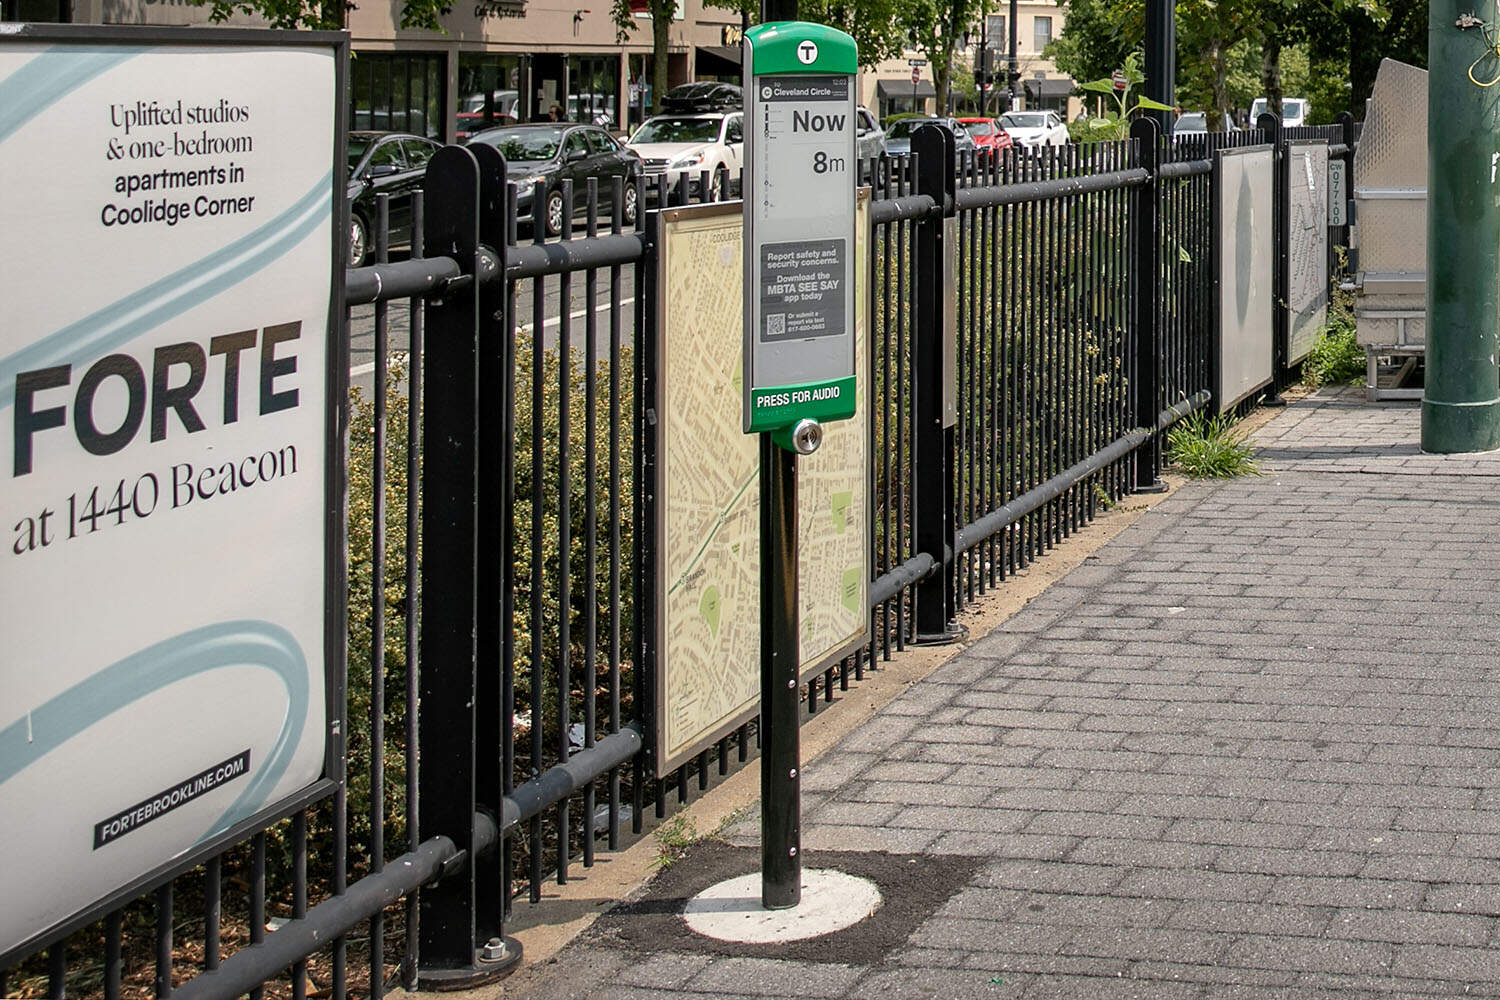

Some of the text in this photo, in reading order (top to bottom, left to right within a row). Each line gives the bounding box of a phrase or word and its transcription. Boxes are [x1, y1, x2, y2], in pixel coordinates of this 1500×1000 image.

[800, 46, 815, 60] T
[774, 87, 809, 96] Cleveland
[810, 87, 832, 96] Circle
[110, 99, 250, 135] Uplifted studios
[793, 110, 846, 132] Now
[106, 130, 253, 160] & one-bedroom
[813, 151, 845, 174] 8m
[1330, 163, 1343, 171] CW
[115, 162, 245, 198] apartments in
[101, 195, 255, 227] Coolidge Corner
[767, 249, 836, 261] Report safety and
[767, 258, 839, 269] security concerns.
[767, 280, 839, 295] MBTA SEE SAY
[777, 271, 830, 283] Download the
[784, 292, 822, 303] app today
[13, 320, 303, 478] FORTE
[757, 386, 840, 408] PRESS FOR AUDIO
[13, 445, 299, 554] at 1440 Beacon
[102, 758, 244, 841] FORTEBROOKLINE.COM
